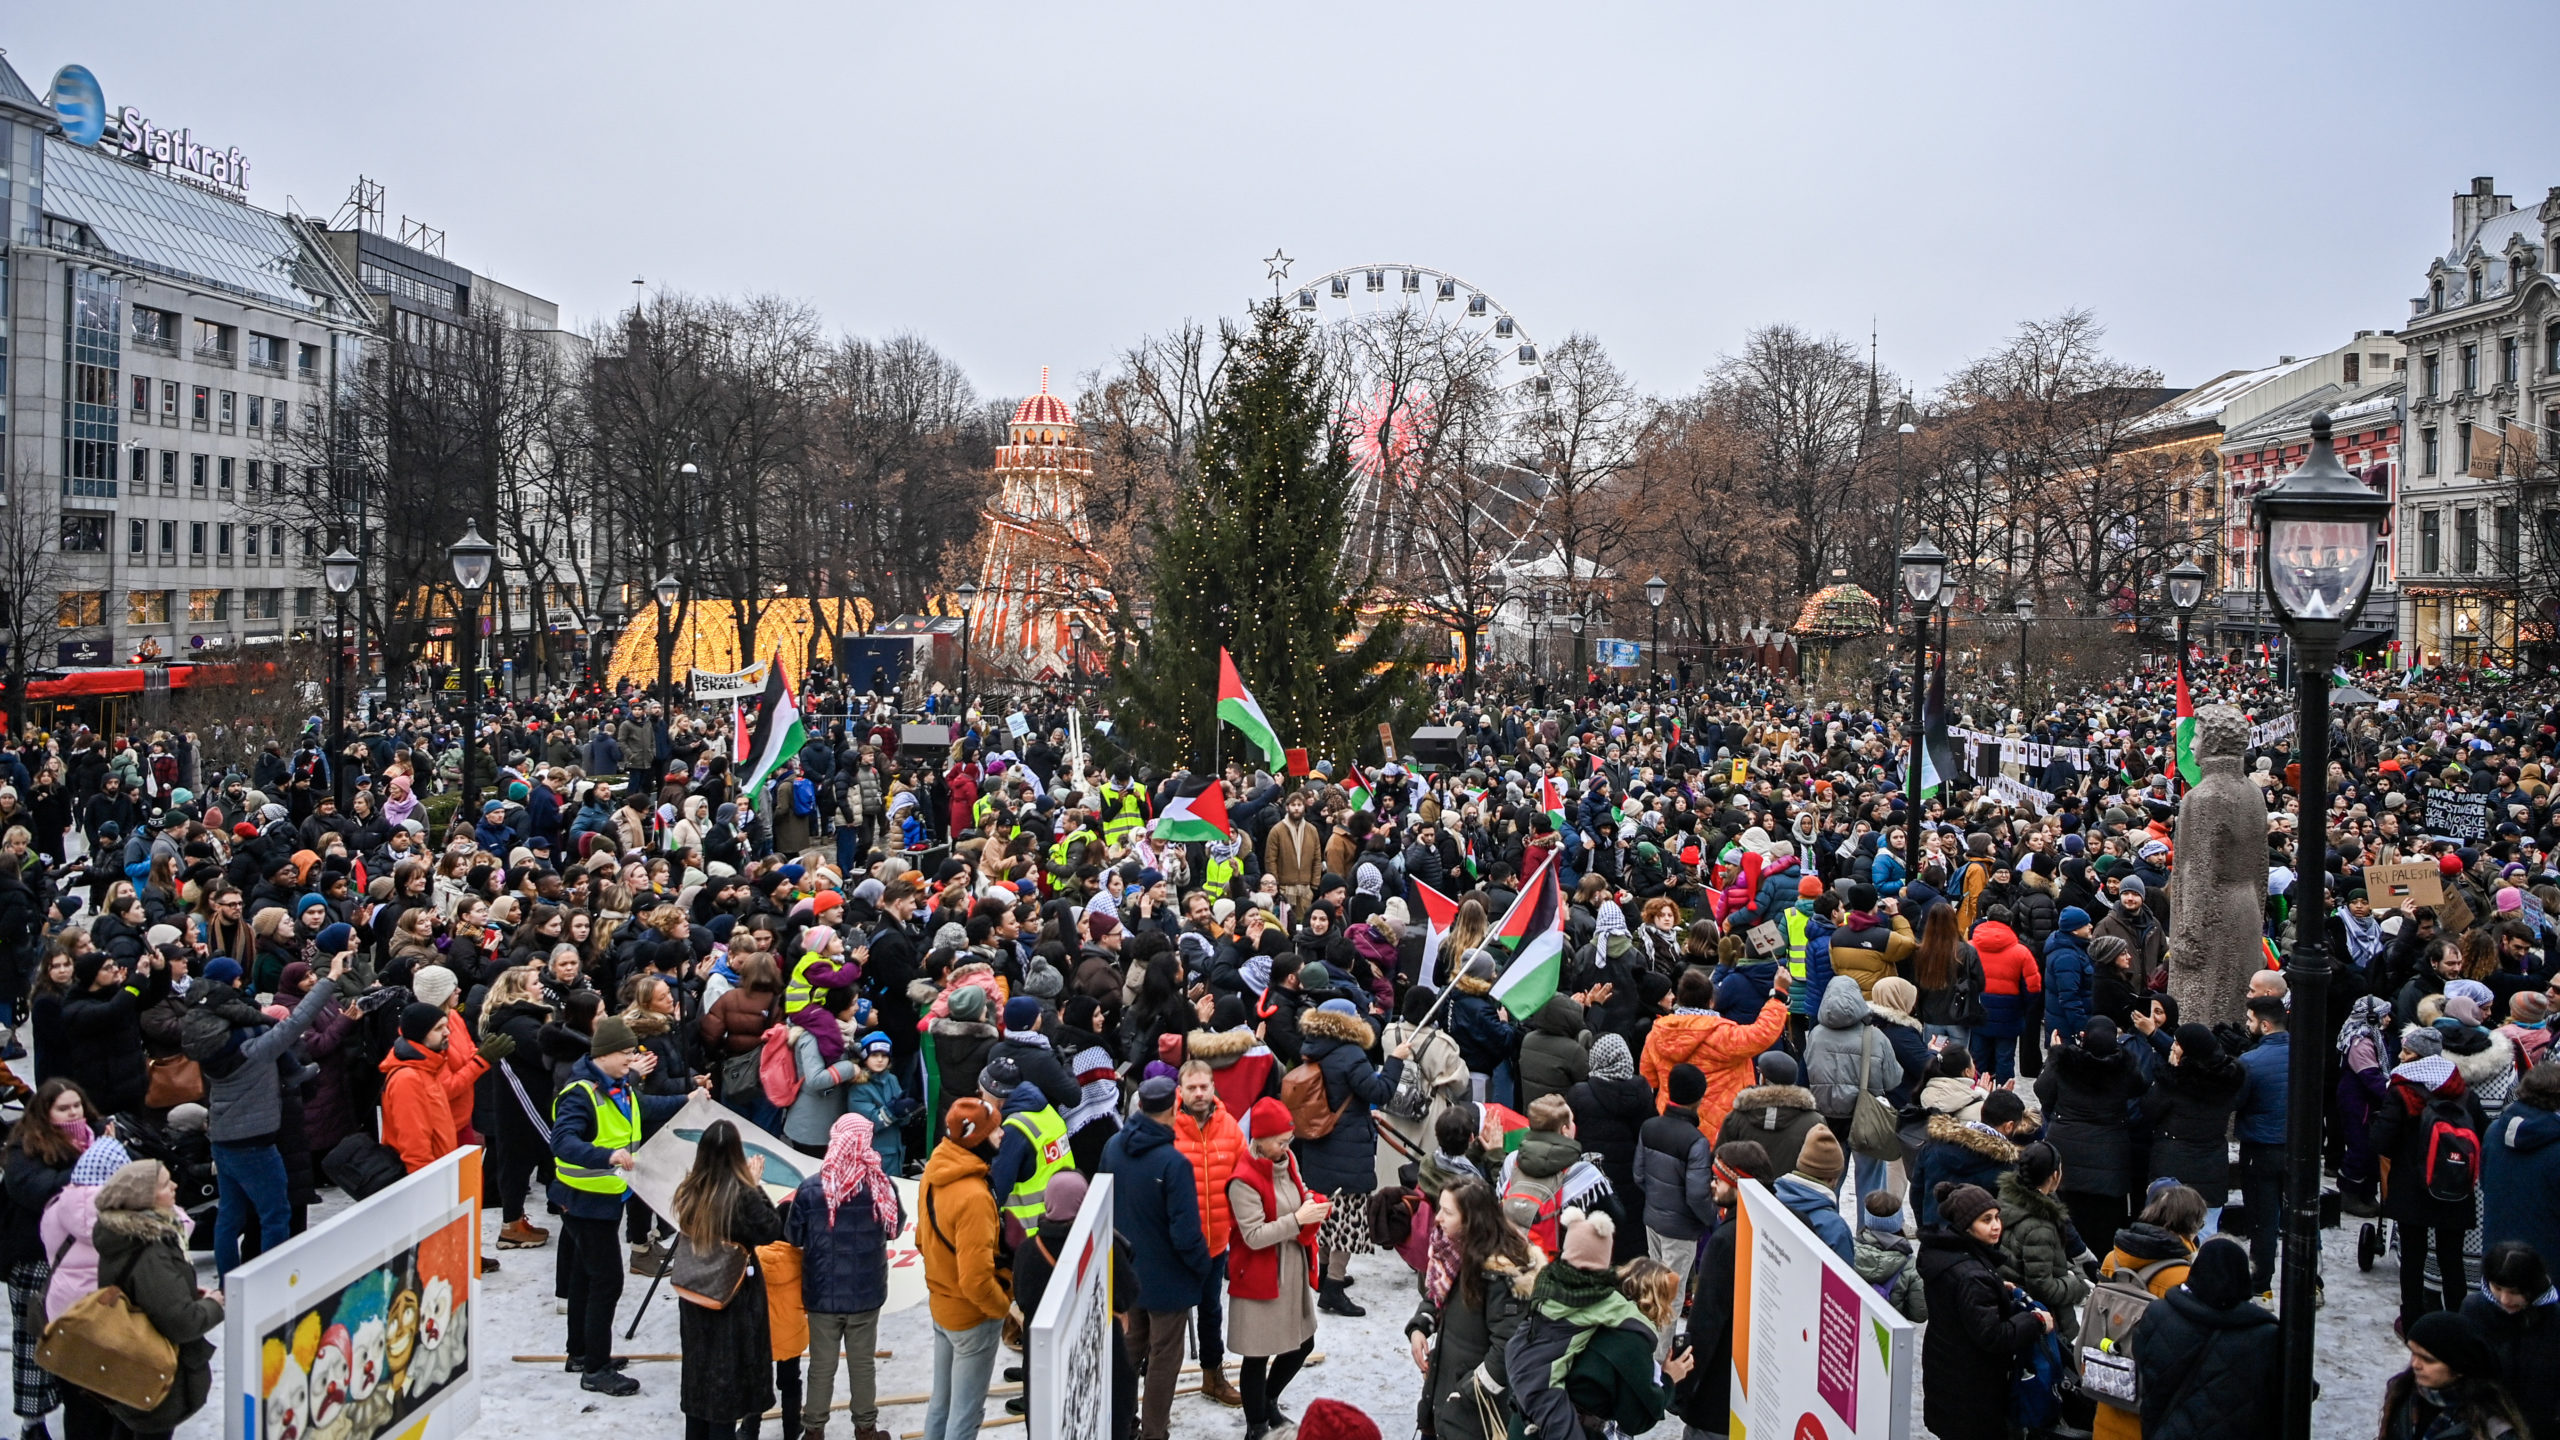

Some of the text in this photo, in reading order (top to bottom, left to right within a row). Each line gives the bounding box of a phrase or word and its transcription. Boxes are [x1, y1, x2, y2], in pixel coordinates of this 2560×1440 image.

[123, 106, 250, 191] Statkraft
[695, 674, 738, 683] BOIKOTT
[2427, 787, 2455, 802] HVOR
[2425, 807, 2485, 827] SKAL NORSKE
[2450, 824, 2486, 839] DREPE
[2369, 871, 2388, 885] FRI
[1043, 1144, 1059, 1160] LO
